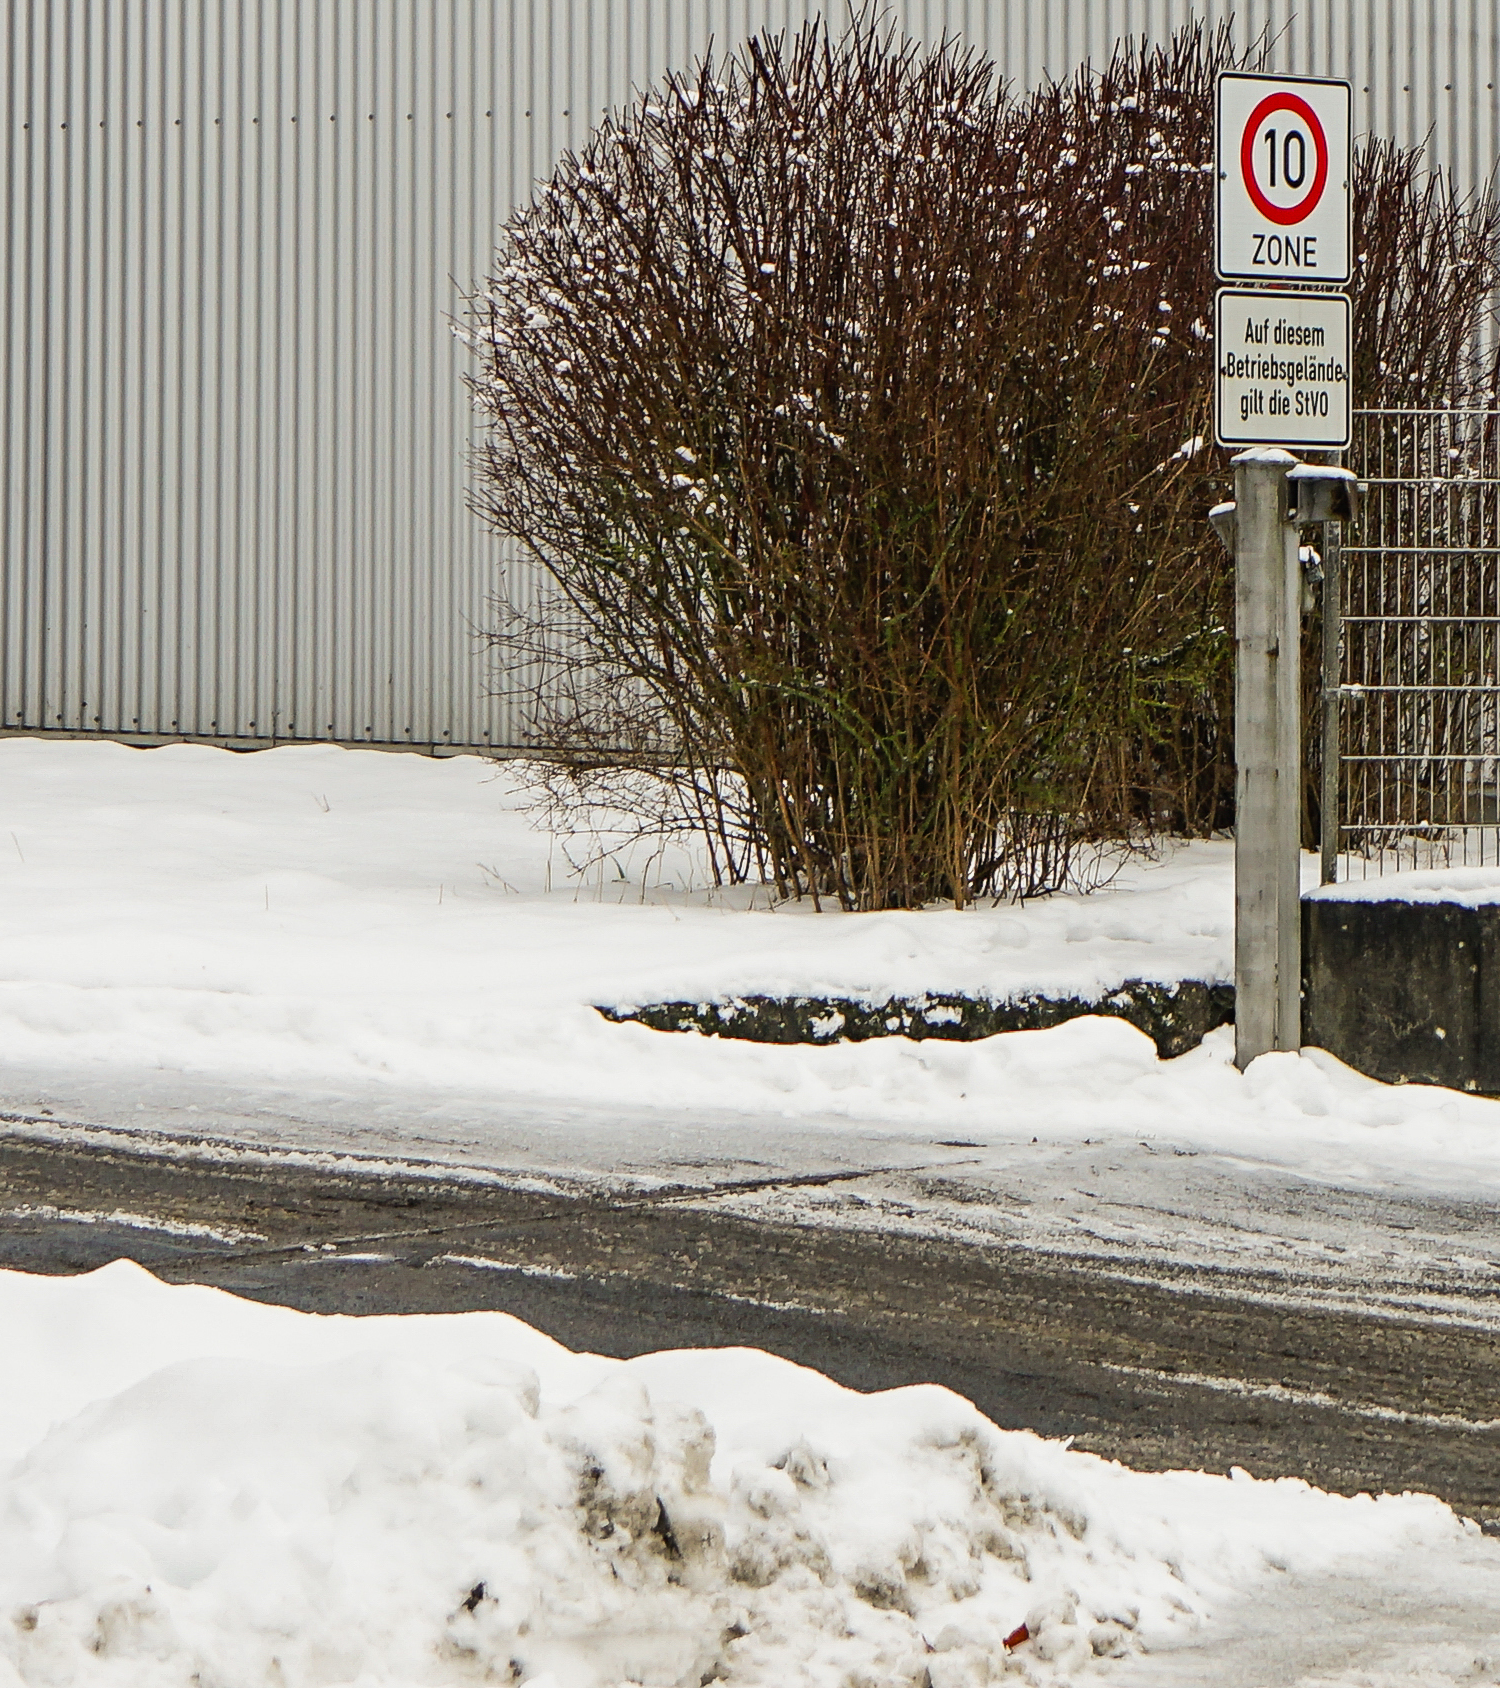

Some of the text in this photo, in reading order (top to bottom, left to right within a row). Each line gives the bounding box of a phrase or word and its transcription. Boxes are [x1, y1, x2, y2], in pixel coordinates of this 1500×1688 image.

[1264, 128, 1307, 189] 10
[1252, 233, 1317, 268] ZONE
[1244, 317, 1325, 347] Auf diesem
[1226, 351, 1343, 387] Betriebsgelände
[1241, 388, 1329, 422] gilt die StVO
